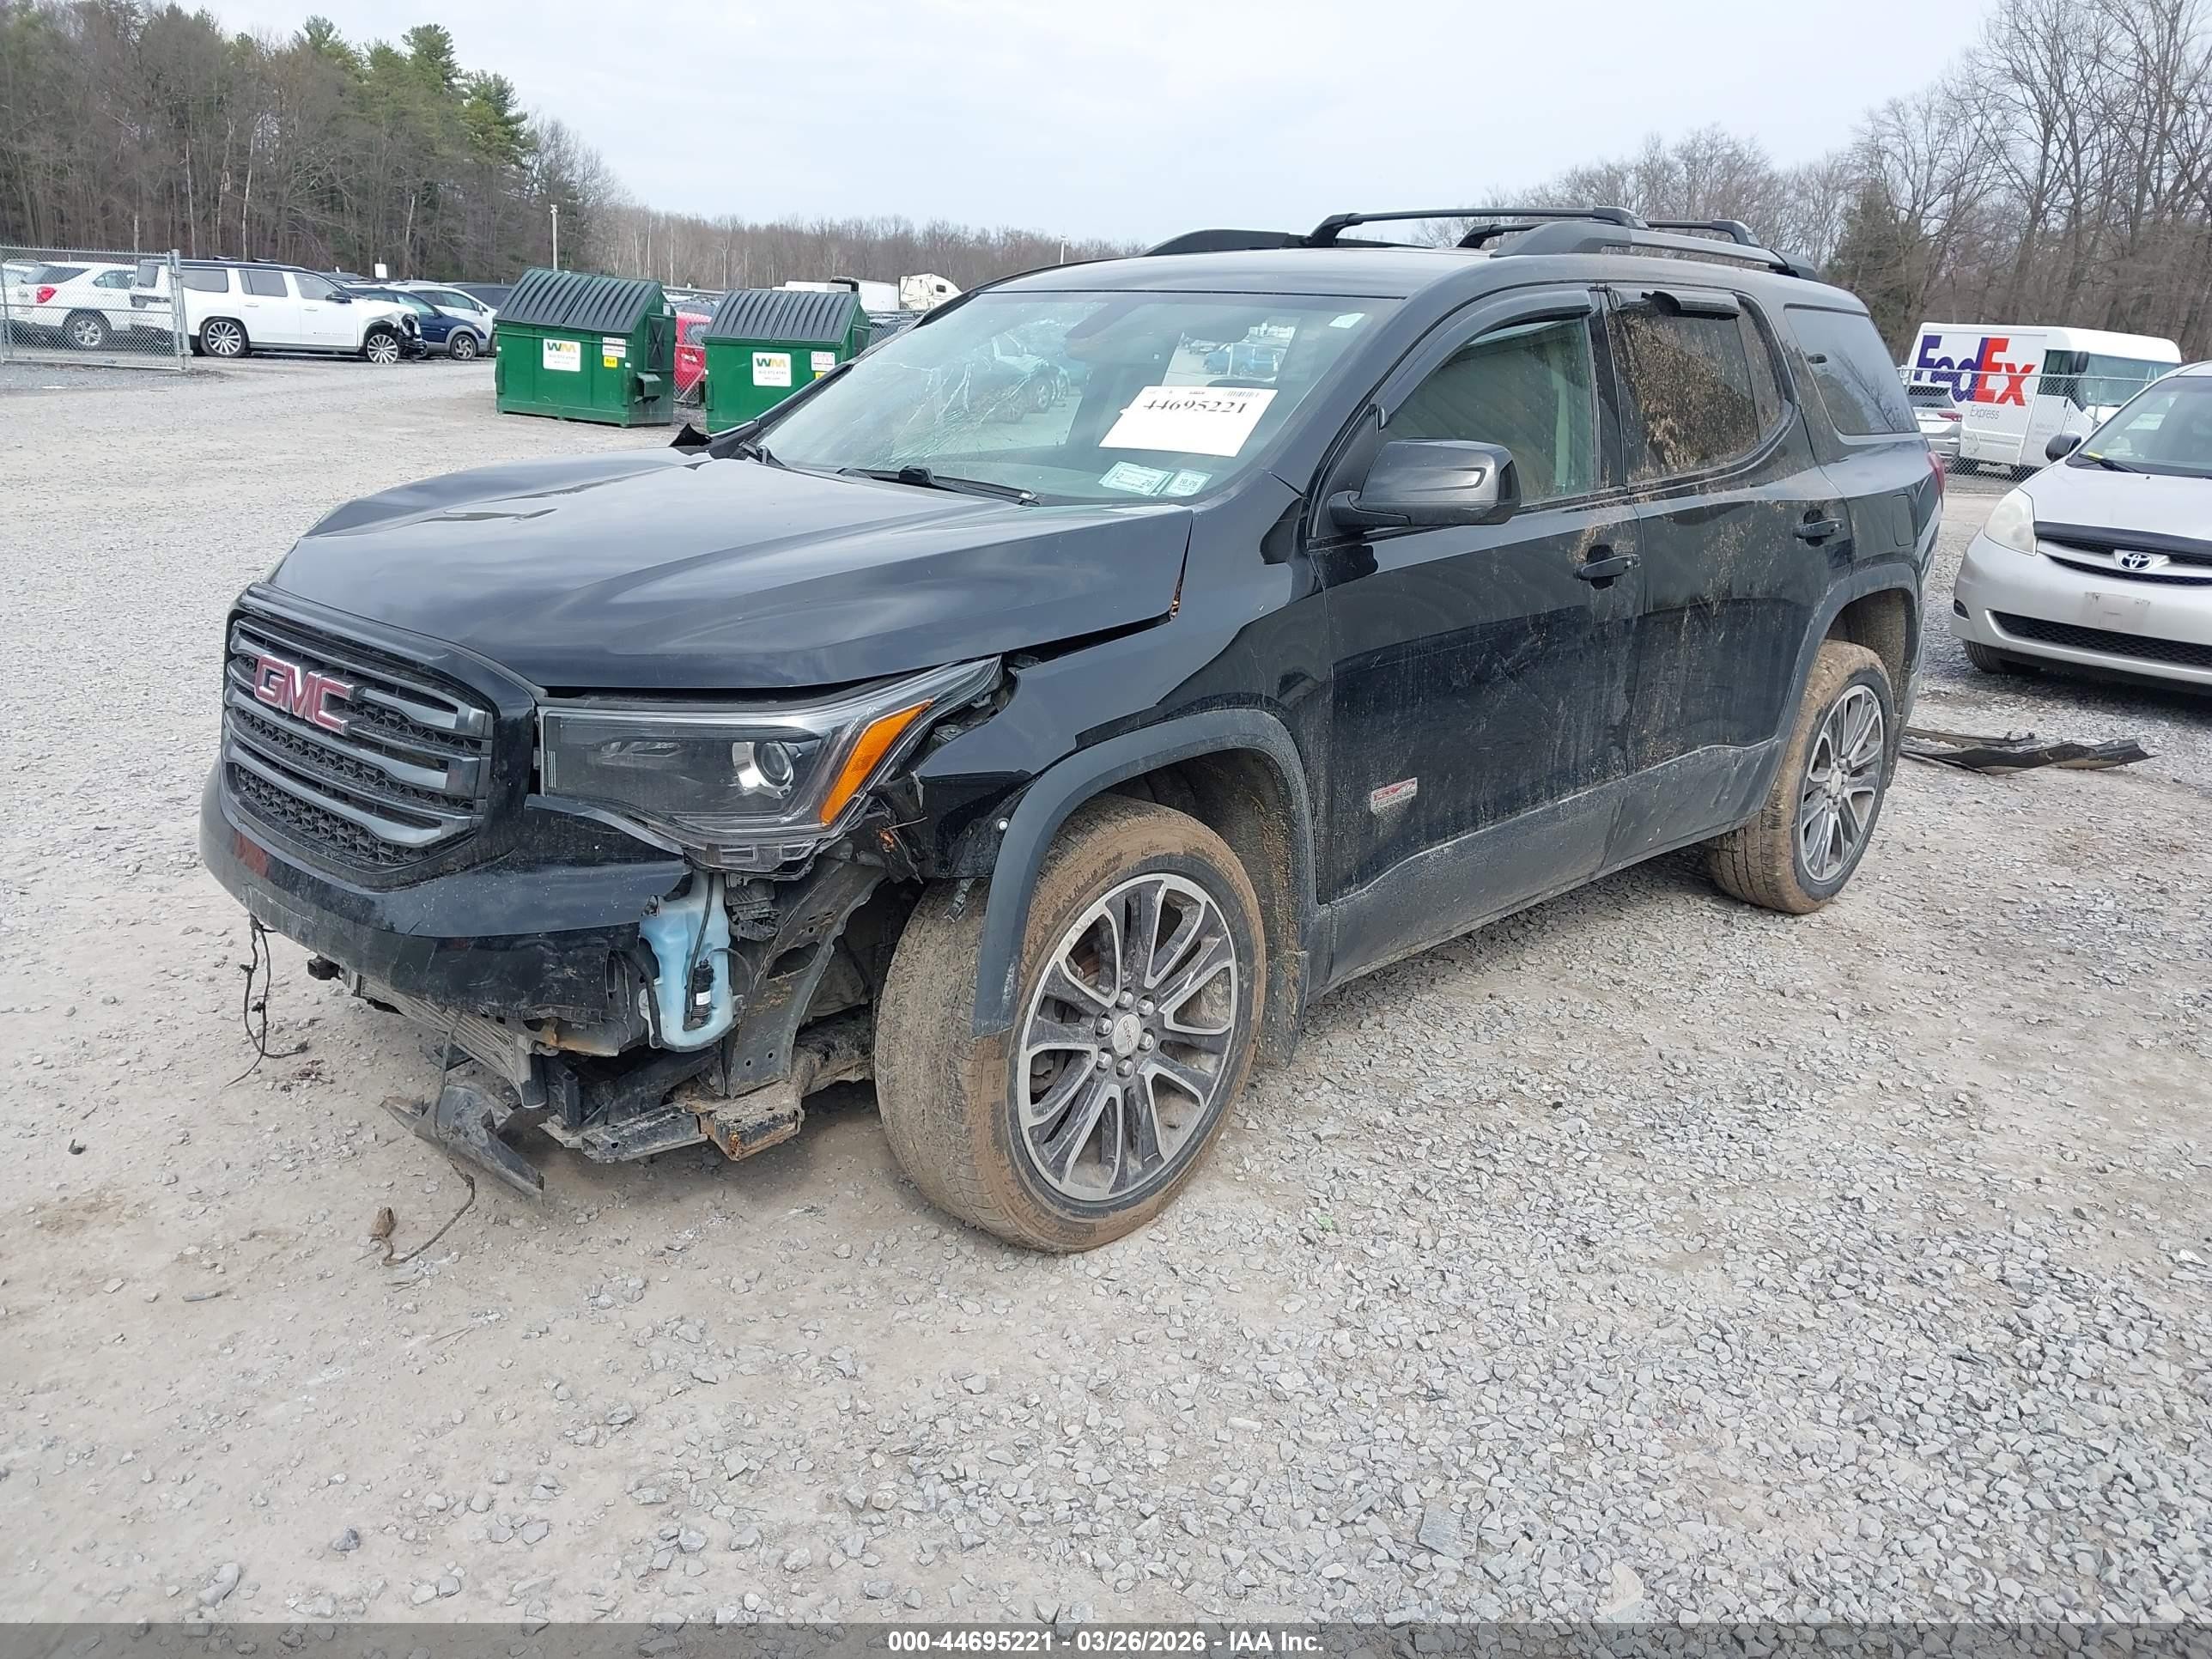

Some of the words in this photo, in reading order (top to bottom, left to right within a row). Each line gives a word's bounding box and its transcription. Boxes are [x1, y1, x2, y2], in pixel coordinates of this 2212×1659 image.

[546, 341, 577, 353] WM
[756, 356, 787, 368] WM
[1913, 334, 2036, 406] FedEx
[1143, 399, 1248, 414] 44695221
[1969, 404, 2000, 420] Express
[253, 654, 354, 736] GMC
[1122, 1019, 1133, 1050] GMC
